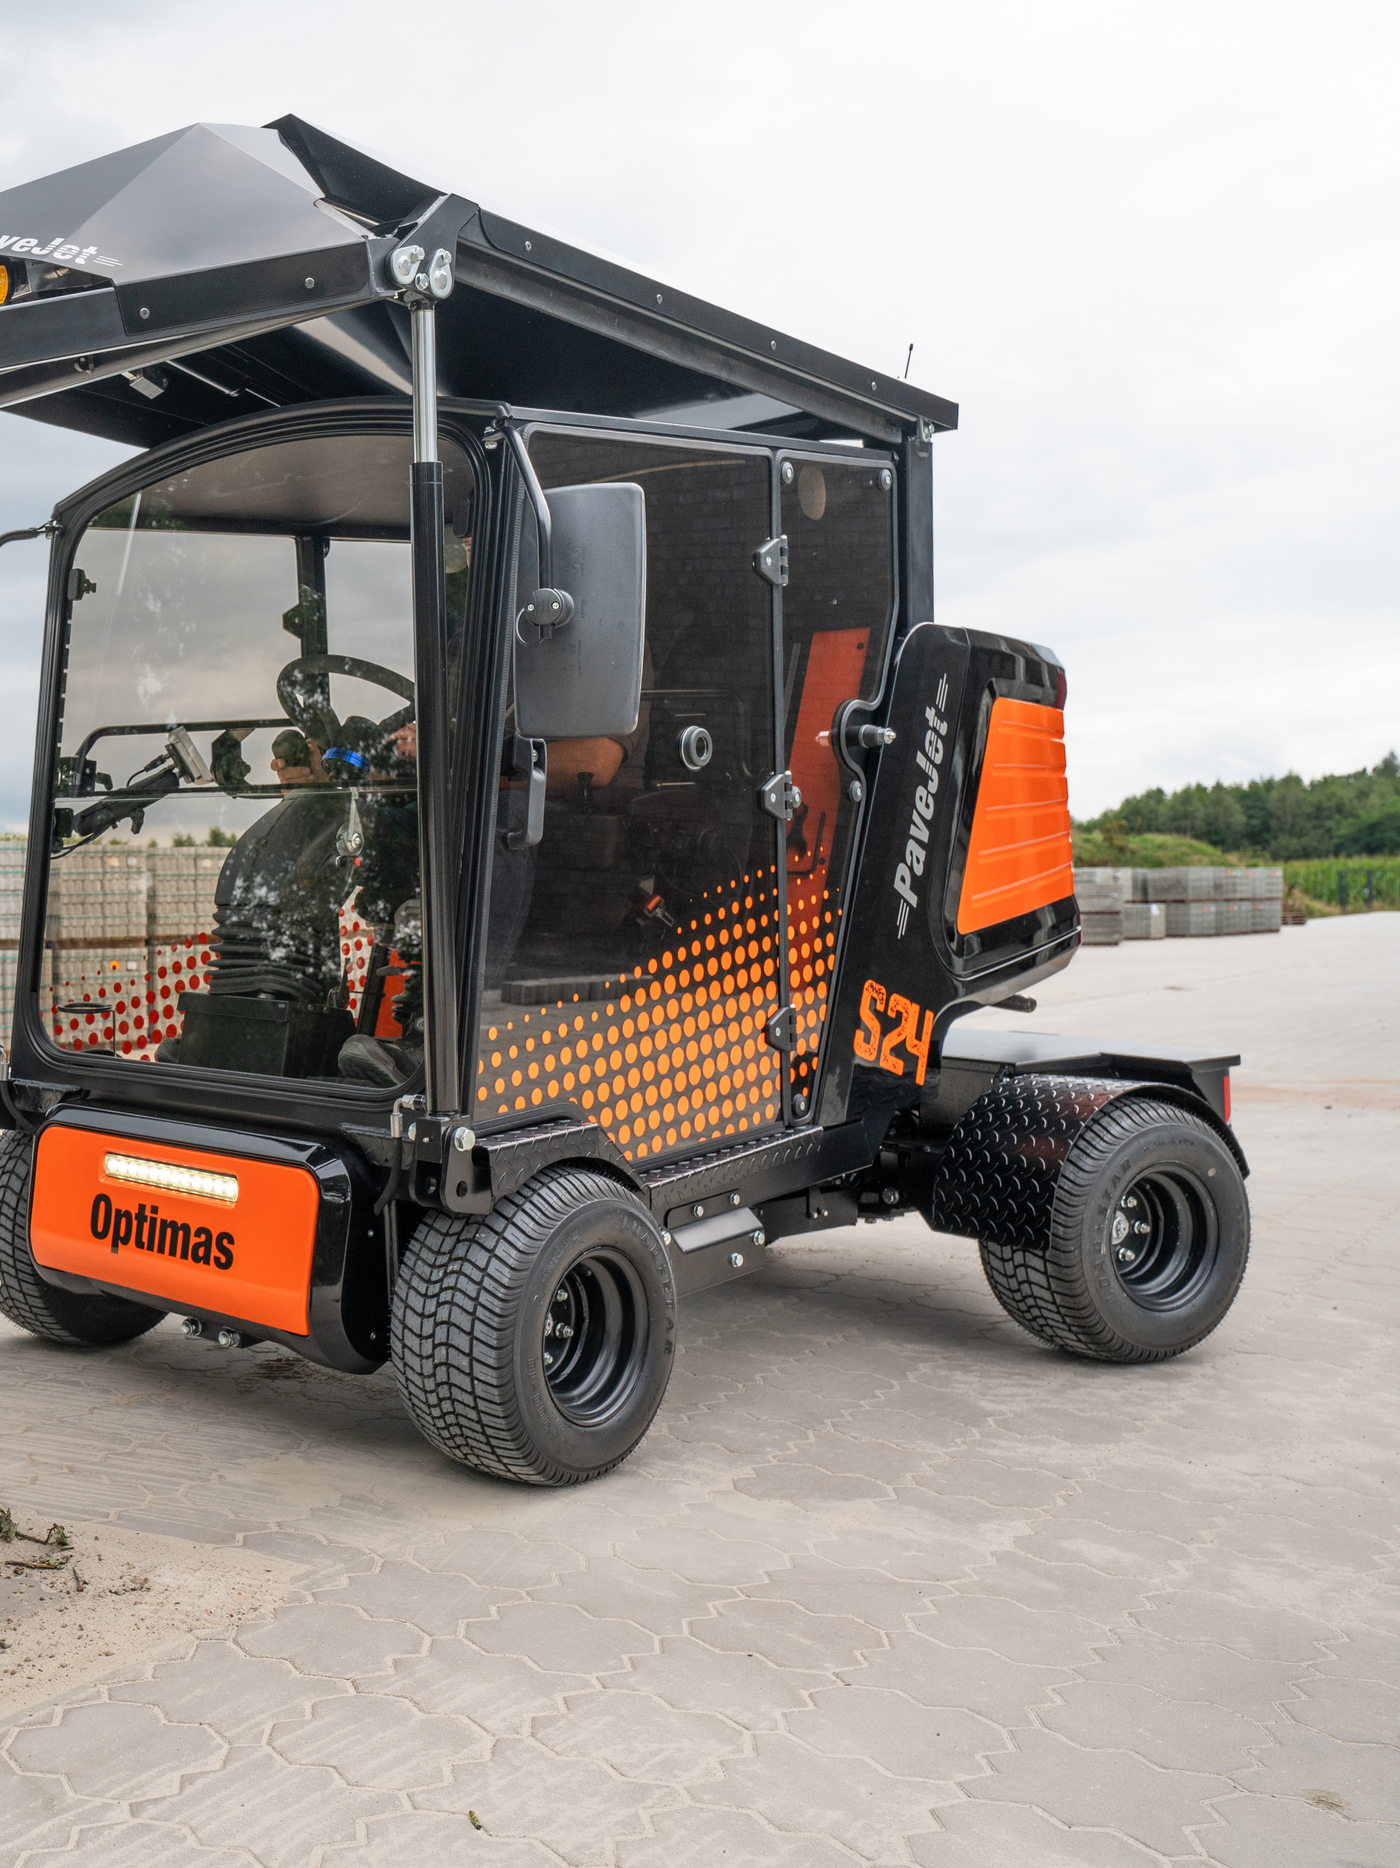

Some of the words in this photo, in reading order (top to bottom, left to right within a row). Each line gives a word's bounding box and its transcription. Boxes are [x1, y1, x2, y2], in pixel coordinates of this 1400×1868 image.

[893, 705, 948, 908] PaveJet
[853, 979, 934, 1086] S24
[90, 1193, 235, 1271] Optimas
